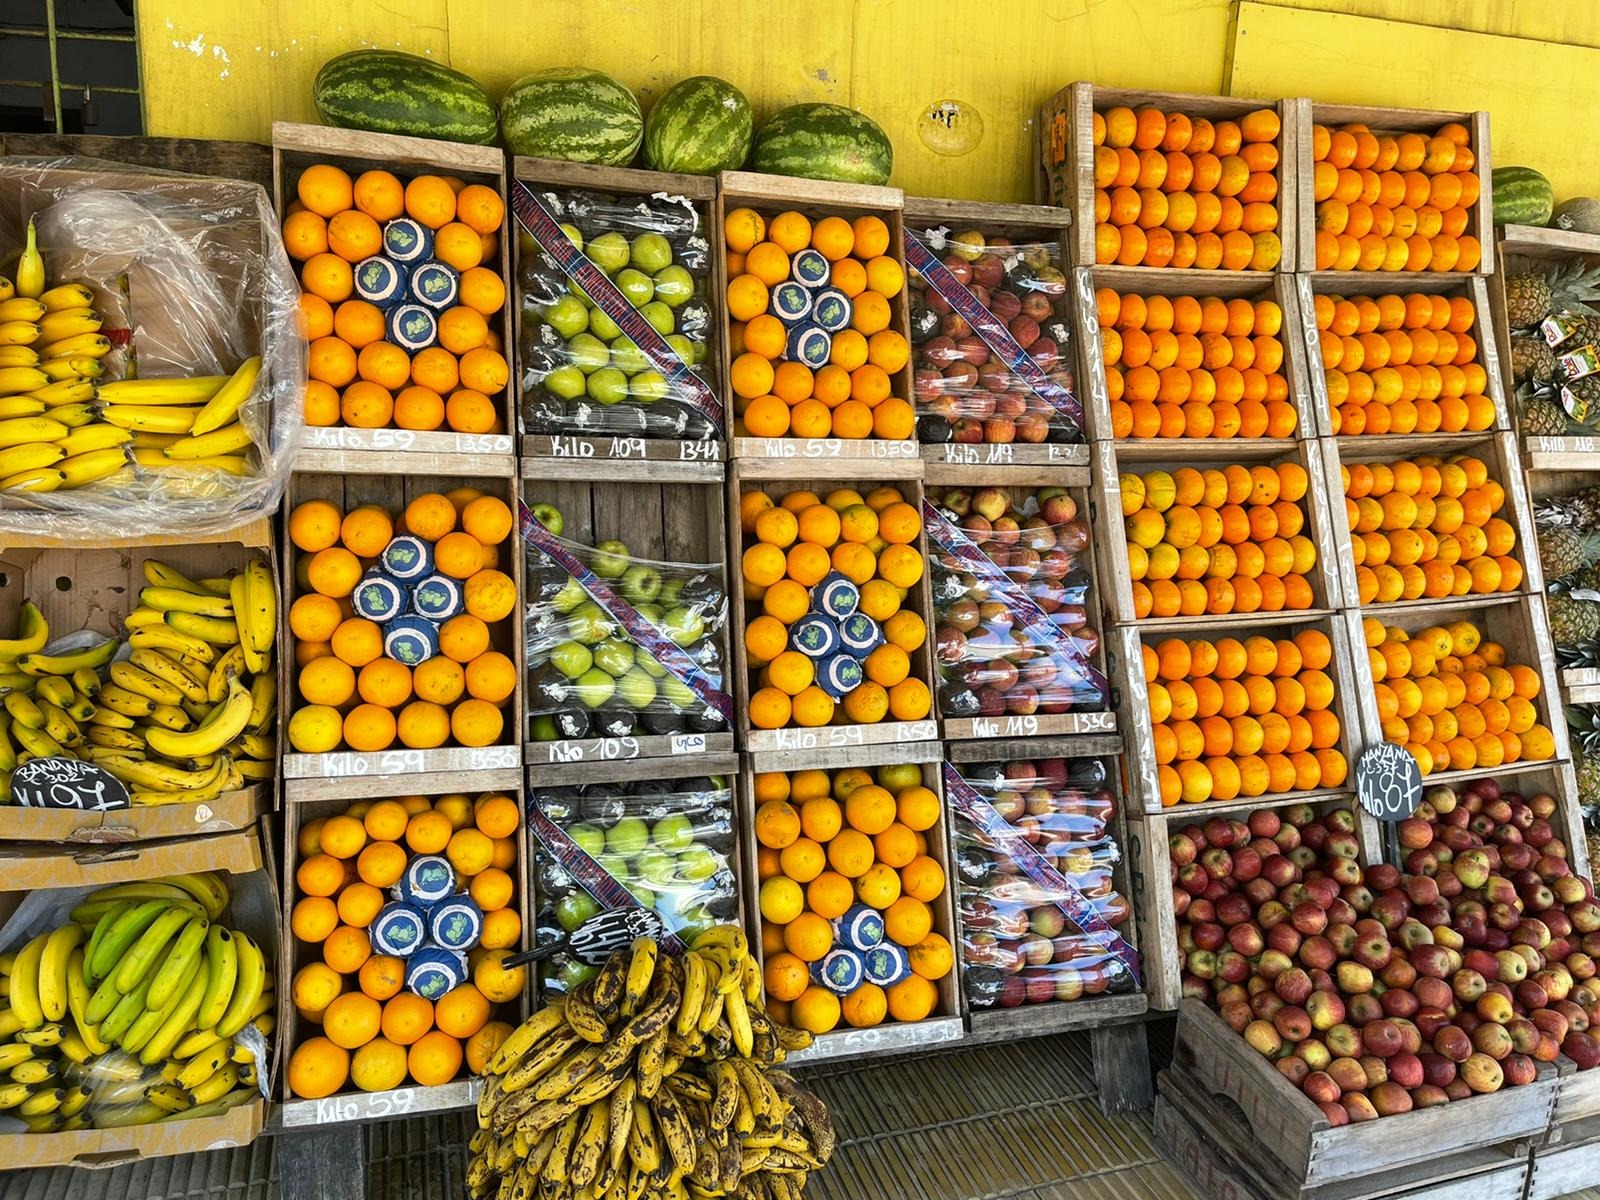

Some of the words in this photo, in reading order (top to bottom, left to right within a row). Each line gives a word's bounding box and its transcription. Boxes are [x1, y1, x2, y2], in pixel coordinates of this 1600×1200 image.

[310, 430, 361, 447] Kilo
[371, 430, 416, 447] 59
[456, 435, 512, 450] 1350
[551, 436, 594, 457] Kilo
[610, 437, 646, 457] 109
[764, 439, 796, 457] Kilo
[803, 438, 841, 457] 59
[870, 440, 916, 457] 1350
[1540, 437, 1565, 452] Kilo
[944, 443, 979, 463] Kilo
[986, 443, 1013, 463] 119
[775, 728, 817, 750] Kilo
[830, 726, 863, 746] 59
[972, 717, 1000, 737] Kilo
[590, 737, 640, 761] 109
[1361, 743, 1417, 768] MANZANA
[16, 758, 99, 782] BANANA
[322, 753, 368, 777] Kilo
[381, 751, 425, 773] 59
[50, 780, 125, 811] 97
[1357, 770, 1384, 817] Kilo
[316, 1098, 358, 1124] Kilo
[366, 1088, 415, 1117] 59
